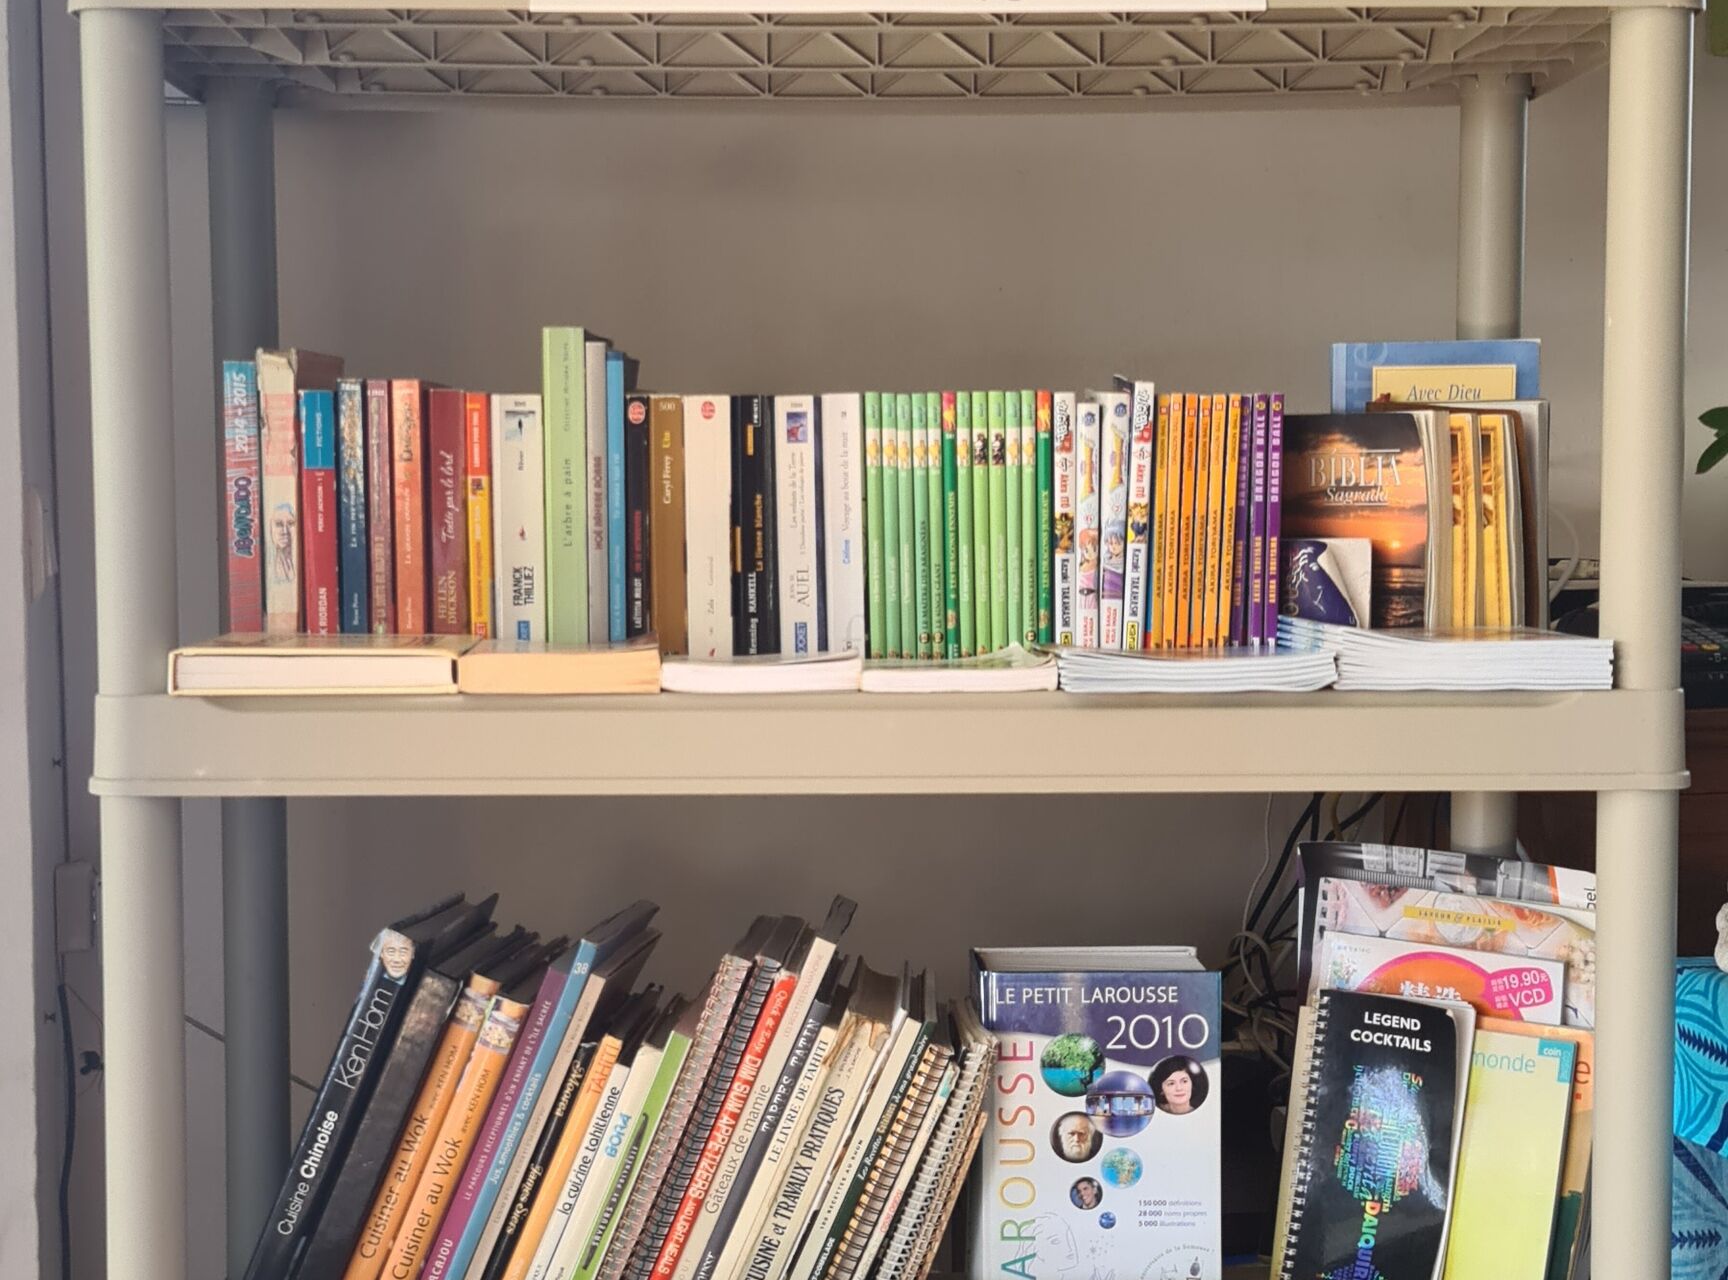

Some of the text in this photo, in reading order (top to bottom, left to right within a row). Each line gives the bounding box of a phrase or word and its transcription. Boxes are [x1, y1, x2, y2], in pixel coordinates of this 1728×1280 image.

[233, 373, 249, 453] 2014 2015
[1407, 383, 1483, 402] Avec Dieu
[1308, 448, 1402, 488] BÍBLIA
[562, 458, 575, 547] L'arbre pain
[662, 480, 673, 504] Caryl
[754, 494, 763, 528] blanche
[1324, 486, 1390, 505] Sagrada
[1183, 515, 1191, 566] TORIYAMA
[436, 575, 447, 618] HELEN
[446, 570, 457, 624] DICKSON
[512, 567, 524, 606] FRANCK
[523, 566, 534, 606] THILLIEZ
[796, 565, 810, 607] AUEL
[1060, 563, 1070, 632] Kazuki TAKAHASHI
[1129, 548, 1141, 617] Kazuki TAKAHASHI
[318, 587, 328, 626] RIORDAN
[748, 572, 759, 654] Henning MANKELL
[572, 961, 588, 976] 38
[995, 986, 1179, 1005] LE PETIT LAROUSSE
[1507, 988, 1546, 1009] VCD
[1105, 1013, 1210, 1050] 2010
[1350, 1029, 1432, 1053] COCKTAILS
[1363, 1011, 1422, 1032] LEGEND
[553, 1060, 585, 1117] Moorea
[587, 1044, 619, 1097] TAHITI
[762, 1077, 795, 1134] TARTES
[791, 1019, 819, 1068] TATIN
[277, 986, 391, 1236] Cuisine Chinoise Ken Hom
[768, 1041, 828, 1163] LE LIVRE DE TAHITI
[798, 1085, 845, 1160] PRATIQUES
[605, 1114, 630, 1157] BORA
[688, 1055, 761, 1199] DIM SUM APPETIZERS
[433, 1136, 462, 1177] Wok
[557, 1086, 621, 1215] la cuisine tahitienne
[704, 1084, 770, 1215] Gâteaux de mamie
[358, 1114, 430, 1261] Cuisiner au Wok
[424, 1181, 444, 1205] au
[773, 1162, 811, 1220] TRAVAUX
[771, 1222, 787, 1237] et
